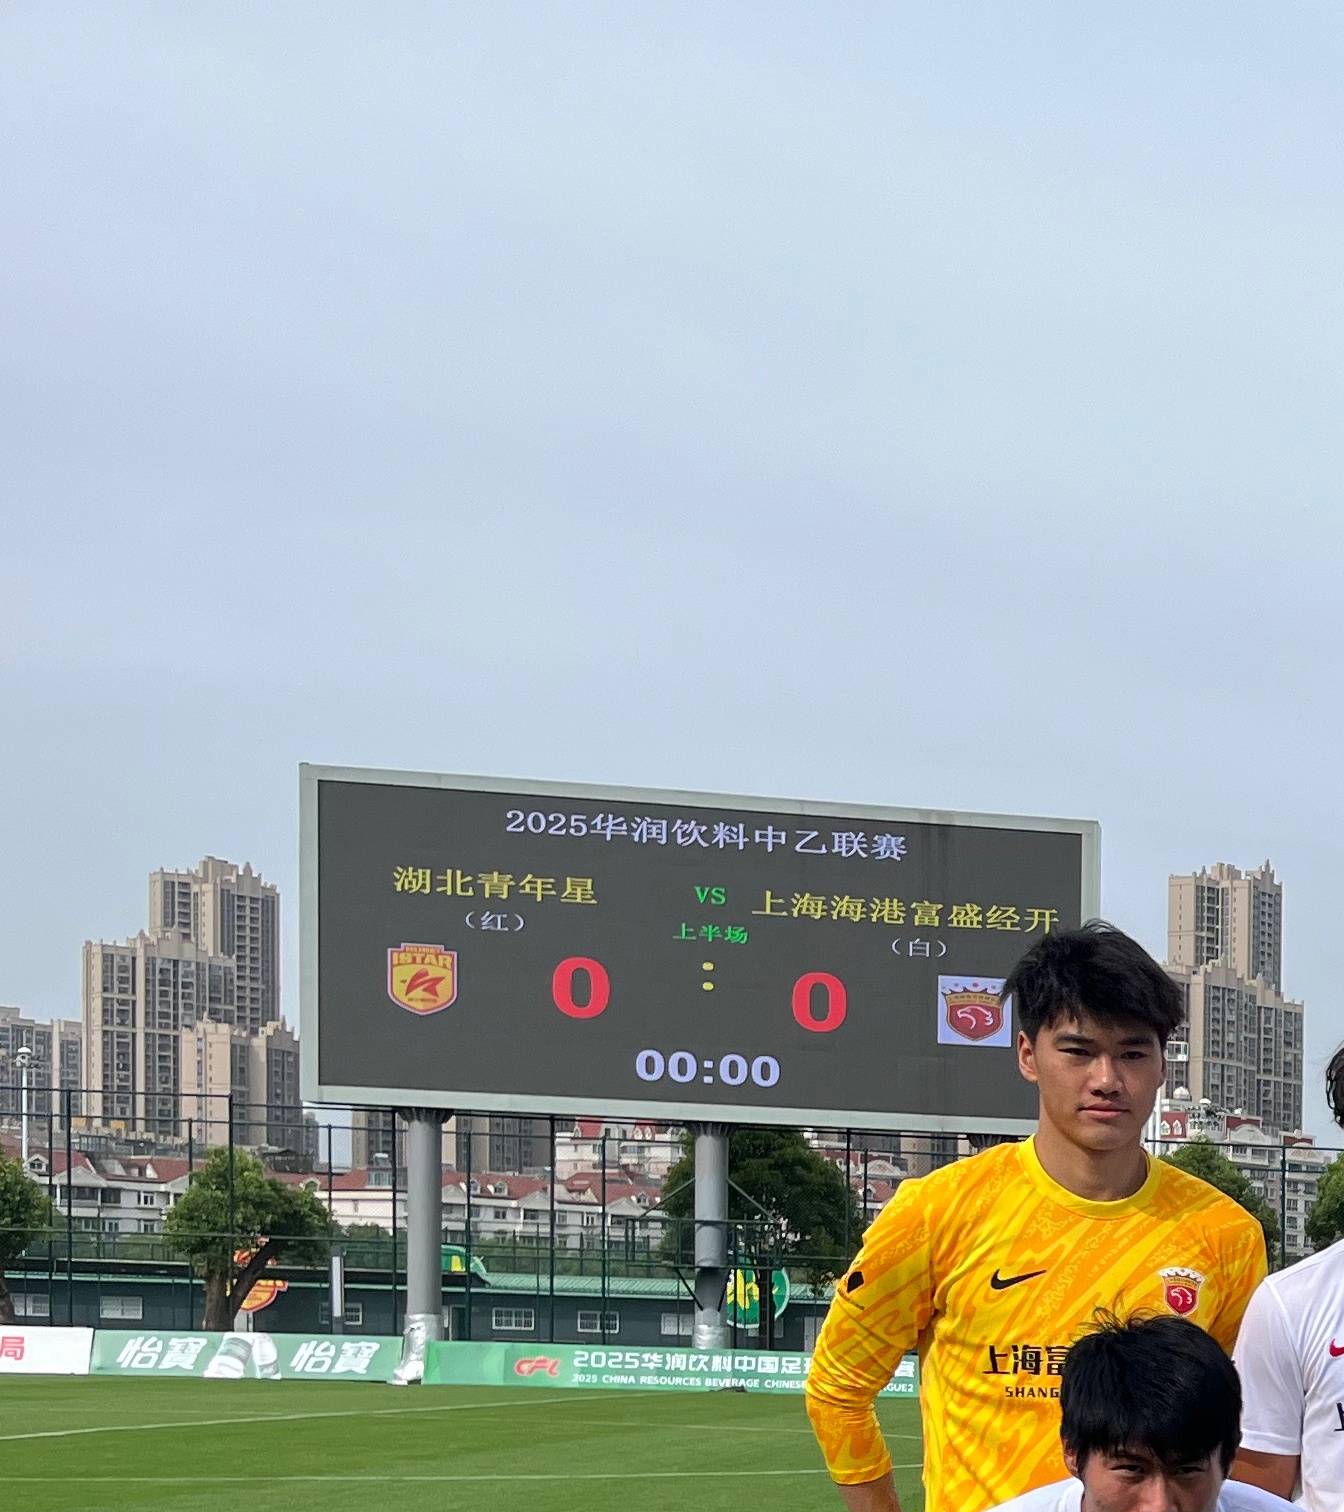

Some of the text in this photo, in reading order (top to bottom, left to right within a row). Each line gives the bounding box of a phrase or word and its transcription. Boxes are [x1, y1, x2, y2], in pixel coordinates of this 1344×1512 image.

[506, 810, 907, 861] 2025华润饮料中乙联赛
[393, 866, 597, 904] 湖北青年星
[694, 886, 726, 904] VS
[752, 890, 1060, 933] 上海海港富盛经开
[672, 922, 748, 944] 上半场
[553, 956, 610, 1019] 0
[792, 971, 847, 1032] 0
[635, 1049, 780, 1087] 00:00
[573, 1374, 597, 1384] 2025
[602, 1375, 635, 1385] CHINA
[640, 1376, 702, 1386] RESOURCES
[705, 1378, 759, 1389] BEVERAGE
